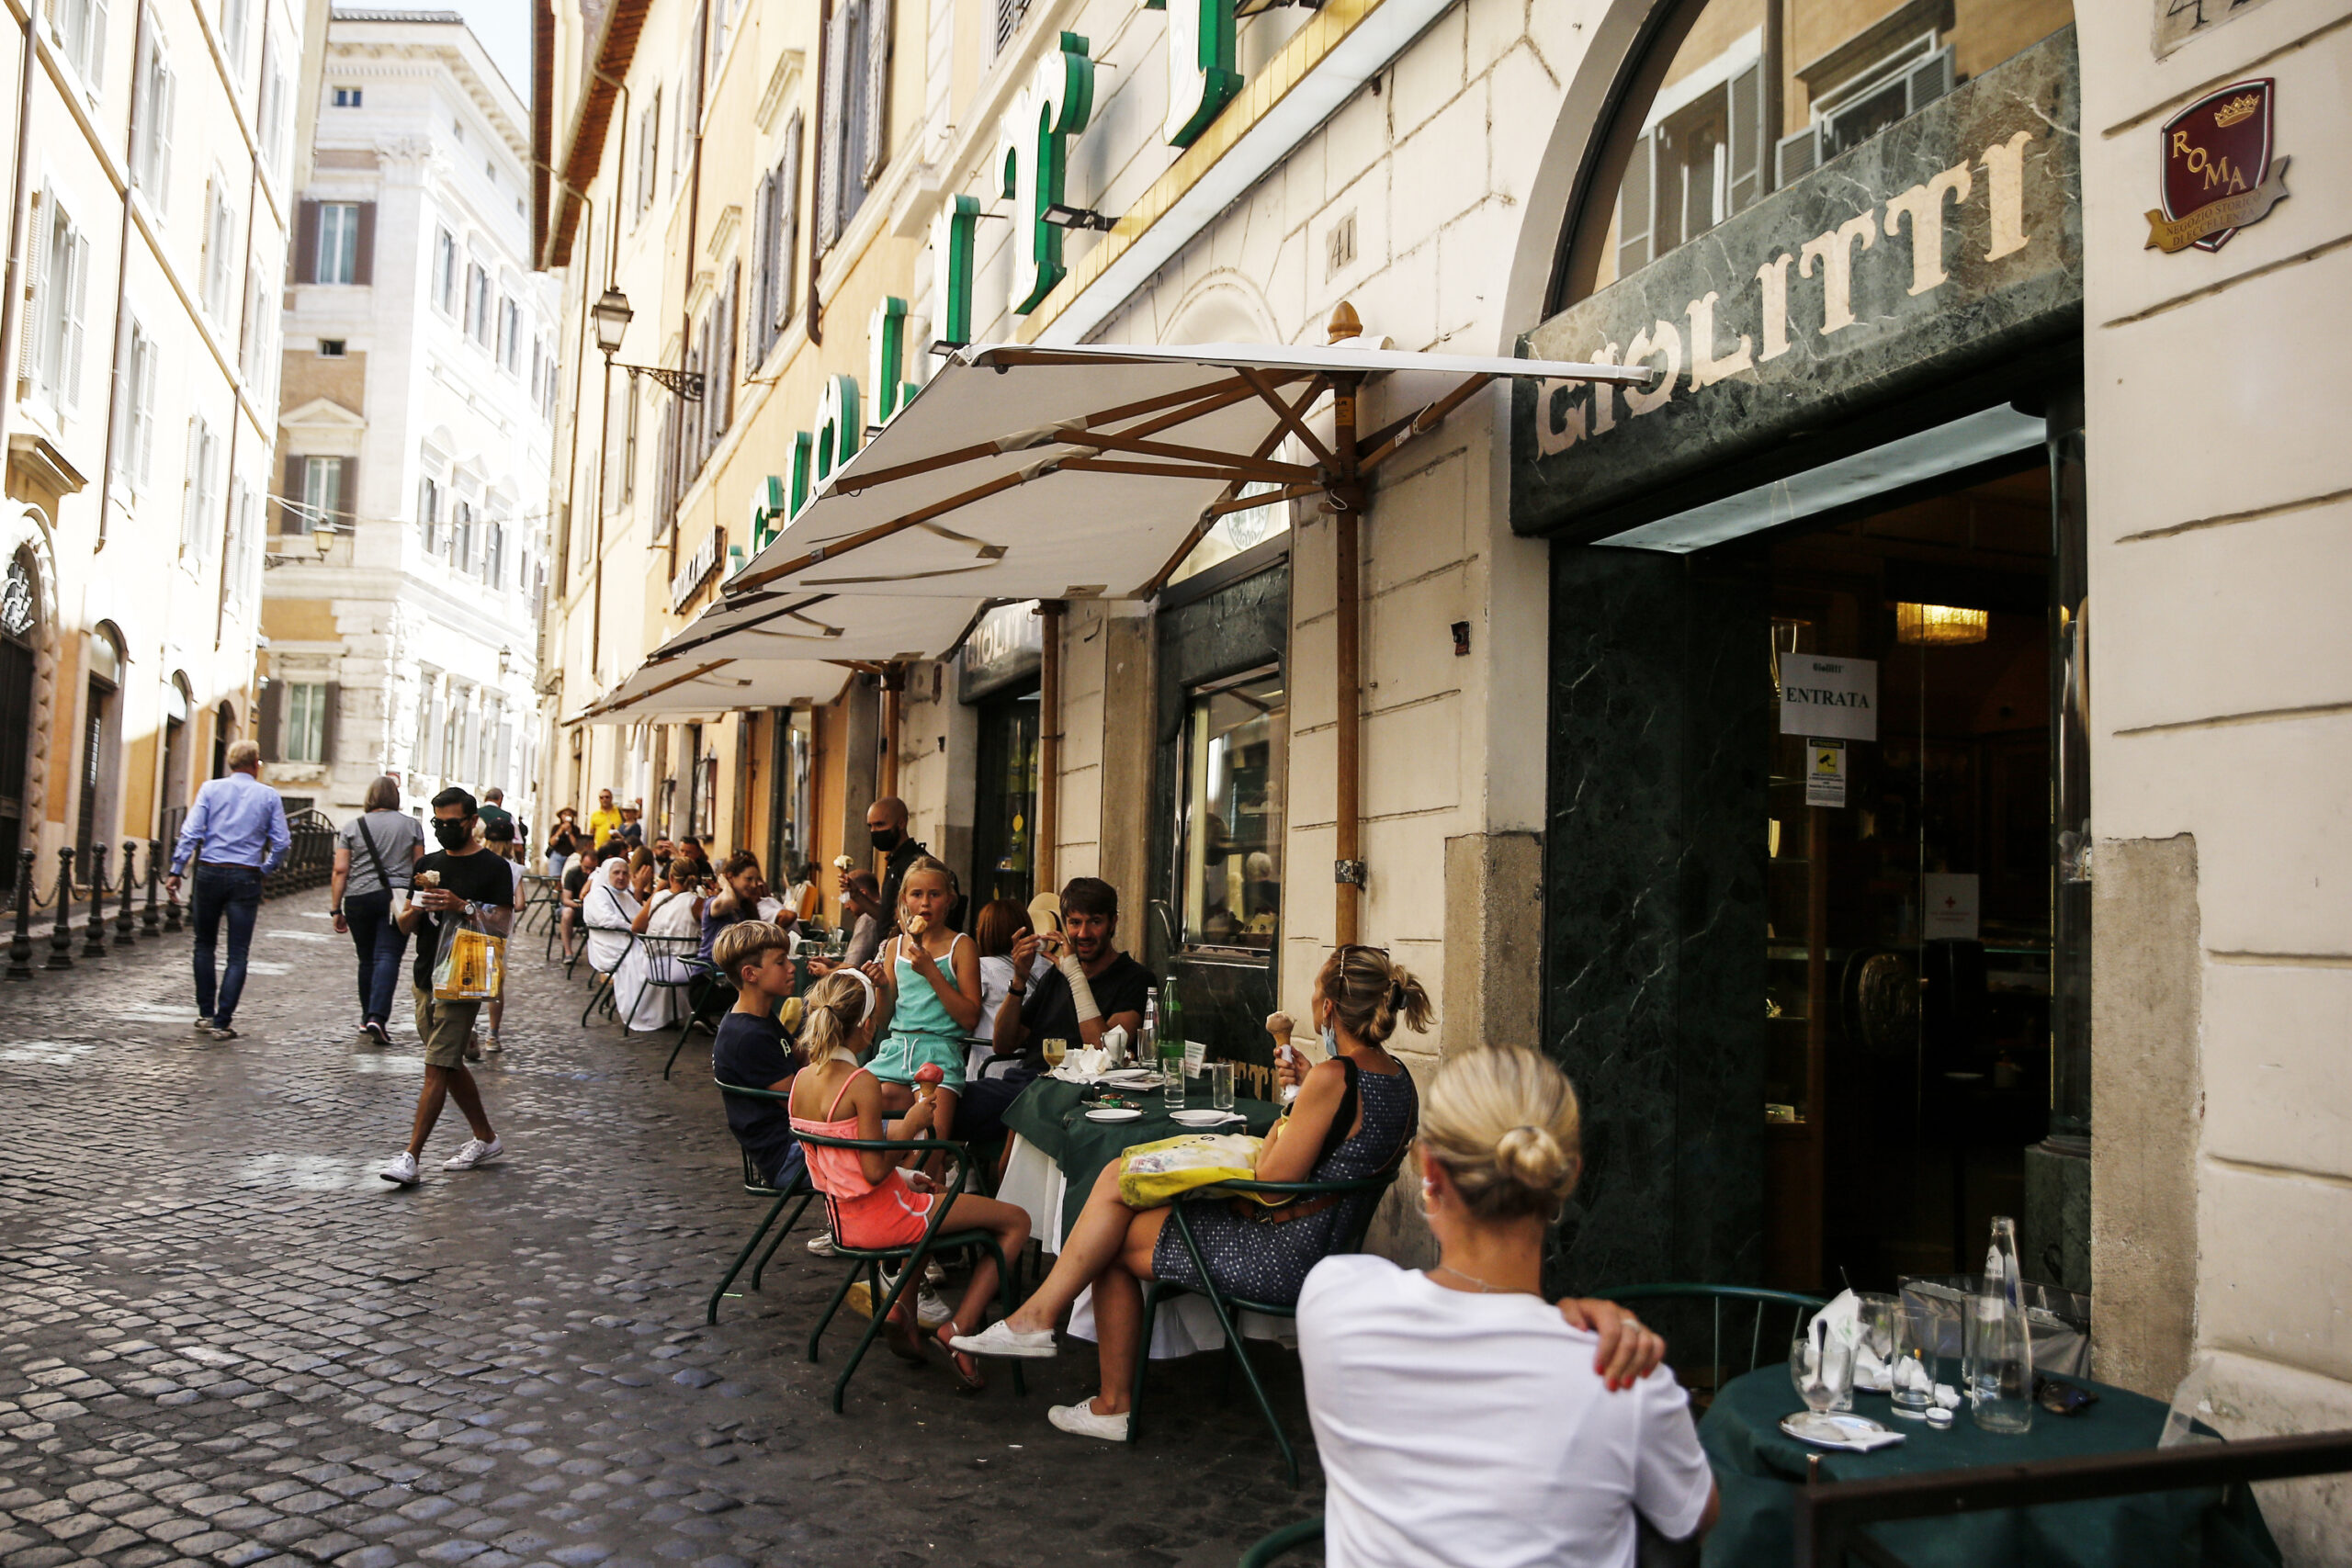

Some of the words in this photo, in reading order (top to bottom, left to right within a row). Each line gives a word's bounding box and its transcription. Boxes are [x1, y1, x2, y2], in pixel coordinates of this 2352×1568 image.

[2172, 130, 2247, 196] ROMA
[2166, 209, 2213, 235] NEGOZIO
[2215, 193, 2261, 214] STORICO
[2172, 234, 2185, 246] DI
[2187, 209, 2255, 239] ECCELLENZA
[1331, 219, 1352, 269] 41
[1535, 130, 2033, 460] GIOLITTI
[1785, 687, 1871, 709] ENTRATA
